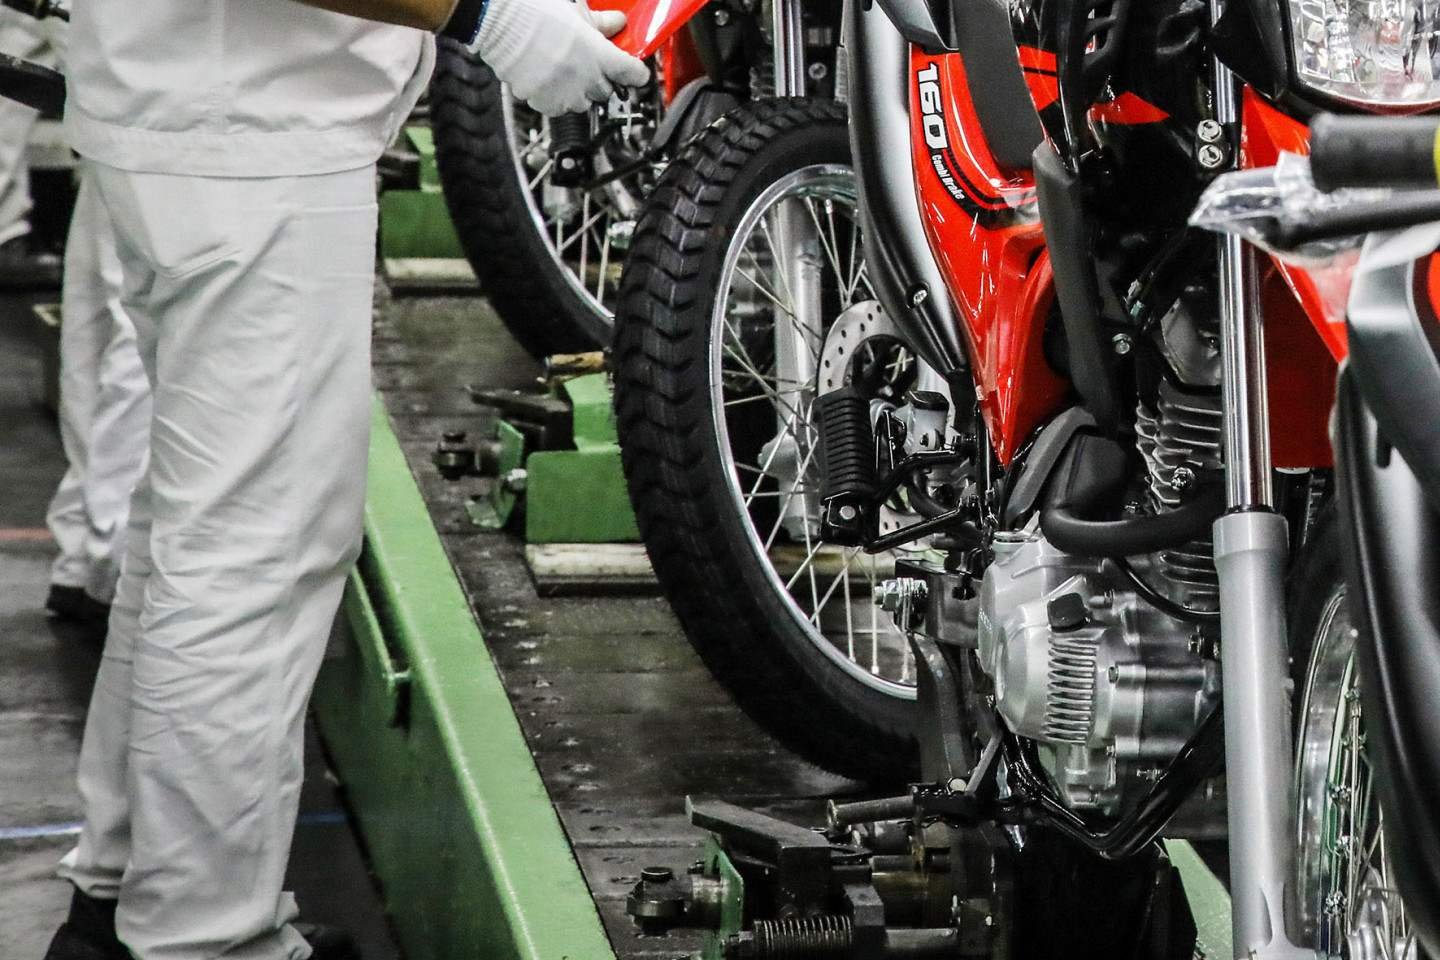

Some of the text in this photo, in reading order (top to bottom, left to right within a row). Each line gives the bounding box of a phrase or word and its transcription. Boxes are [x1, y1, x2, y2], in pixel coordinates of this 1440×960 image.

[918, 62, 966, 200] 160 Combi Brake
